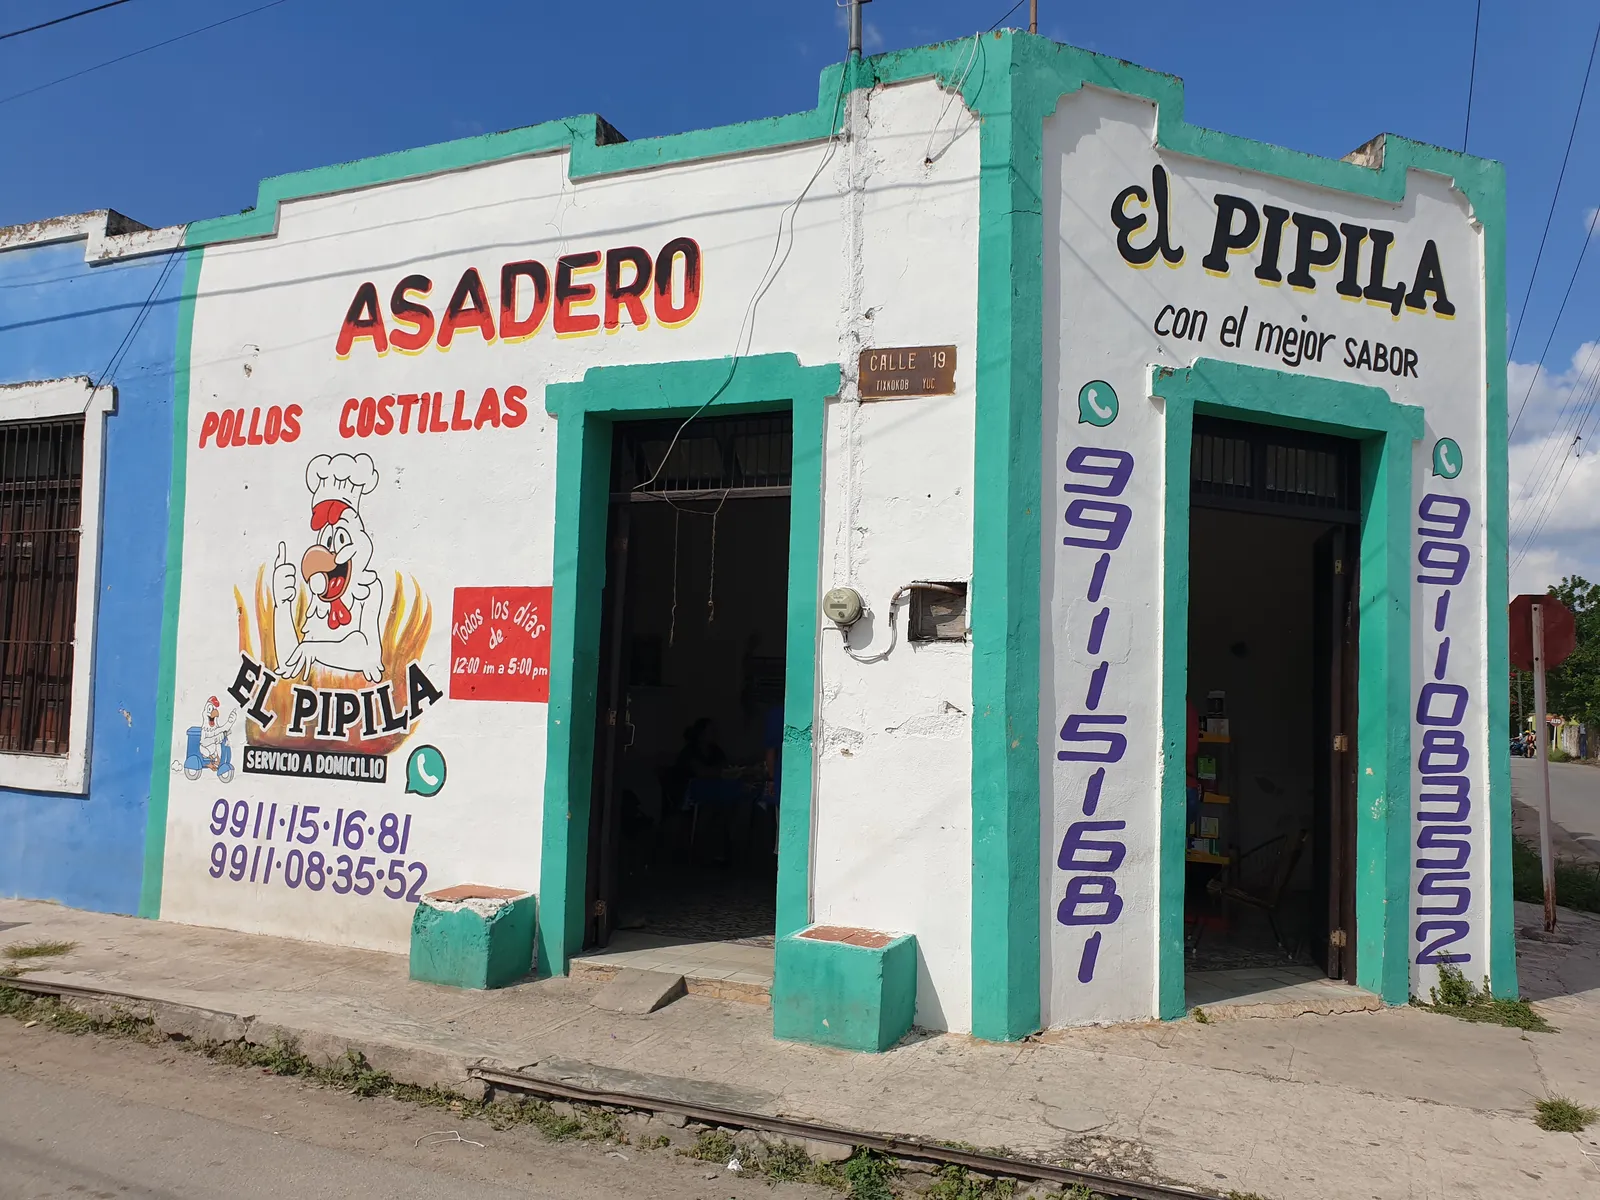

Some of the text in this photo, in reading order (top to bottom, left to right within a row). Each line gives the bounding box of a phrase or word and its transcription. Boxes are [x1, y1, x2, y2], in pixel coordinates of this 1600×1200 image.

[1202, 194, 1456, 321] PIPILA
[336, 236, 703, 360] ASADERO
[870, 351, 946, 371] CALLE 19
[1154, 304, 1419, 378] con el mejor SABOR
[876, 378, 936, 391] TIXKOKOB YUC
[199, 403, 303, 449] POLLOS
[339, 385, 527, 439] COSTILLAS
[452, 596, 546, 646] Todos los días
[489, 627, 504, 650] de
[453, 657, 480, 674] 12:00
[498, 664, 505, 674] a
[507, 657, 533, 676] 5:00
[532, 666, 548, 680] pm
[227, 654, 444, 737] EL PIPILA
[246, 750, 385, 779] SERVICIO A DOMICILIO
